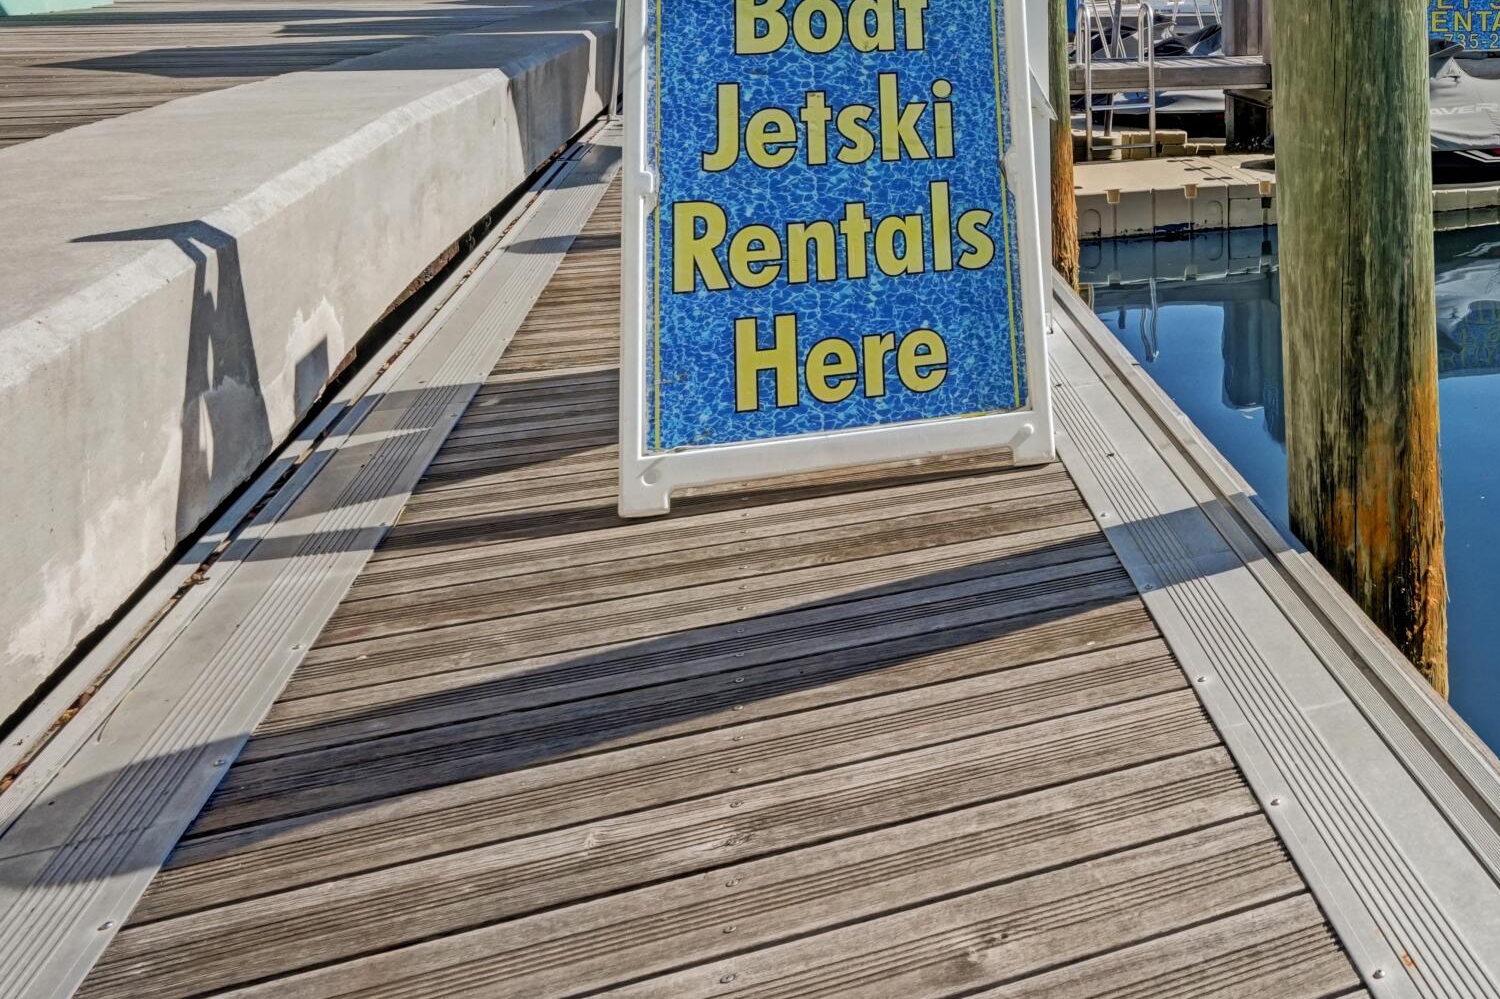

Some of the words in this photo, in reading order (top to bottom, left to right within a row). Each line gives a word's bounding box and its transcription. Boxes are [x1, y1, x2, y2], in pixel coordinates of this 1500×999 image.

[702, 72, 954, 172] Jetski
[671, 180, 996, 294] Rentals
[733, 314, 949, 413] Here
